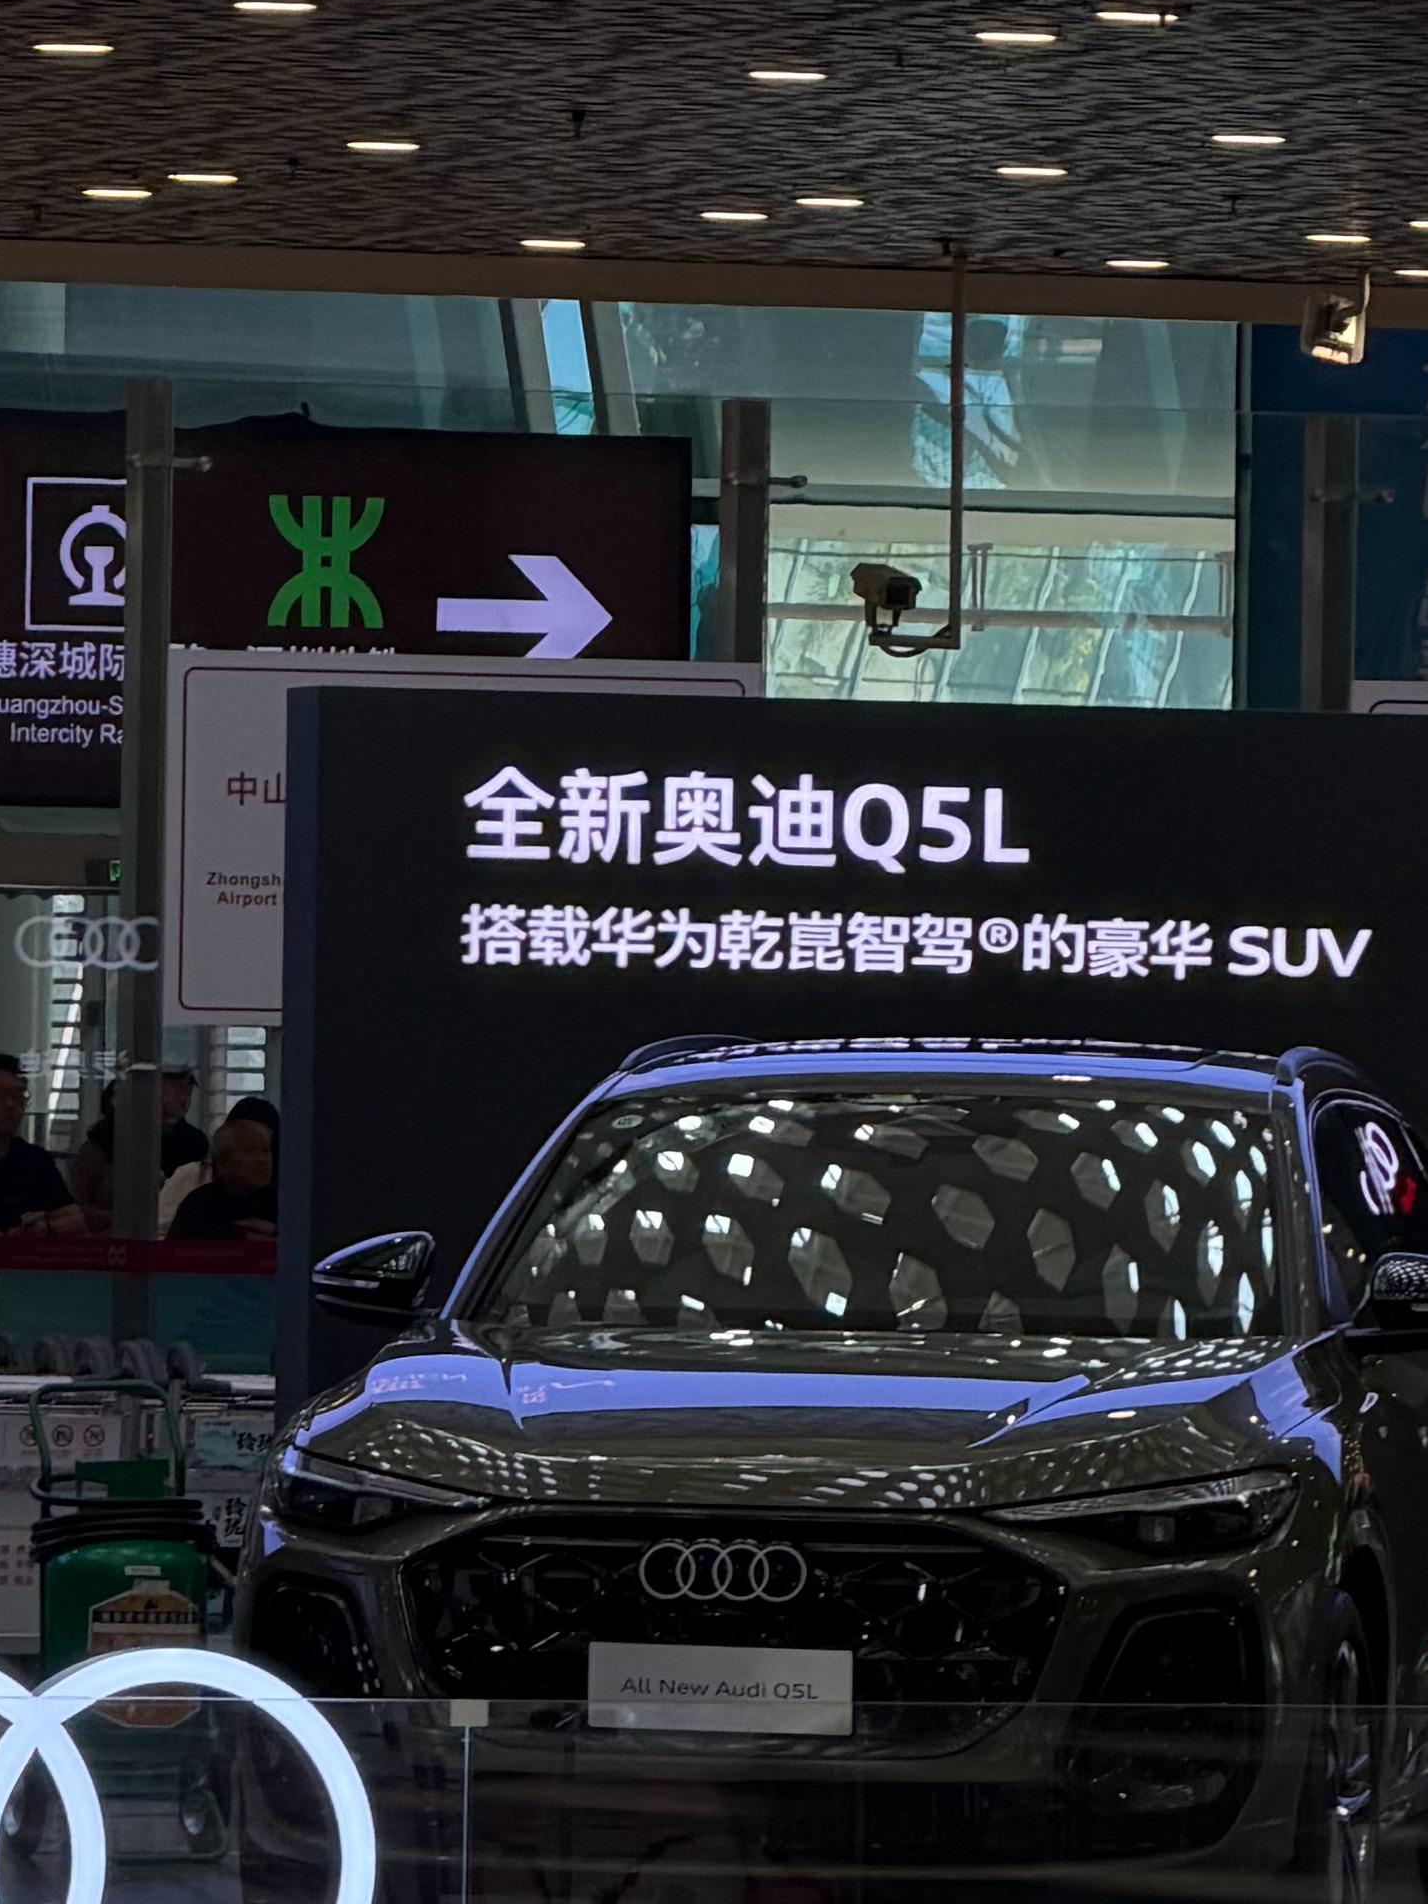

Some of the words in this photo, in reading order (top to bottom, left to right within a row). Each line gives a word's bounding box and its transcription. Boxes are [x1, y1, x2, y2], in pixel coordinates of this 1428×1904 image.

[10, 720, 93, 749] Intercity
[227, 770, 286, 807] 中山
[463, 765, 1030, 874] 全新奥迪Q5L
[205, 871, 282, 889] Zhongsh
[216, 890, 278, 908] Airport
[1227, 925, 1373, 978] SUV
[620, 1677, 653, 1695] All
[659, 1678, 710, 1697] New
[715, 1680, 767, 1699] Audi
[773, 1682, 820, 1701] Q5L
